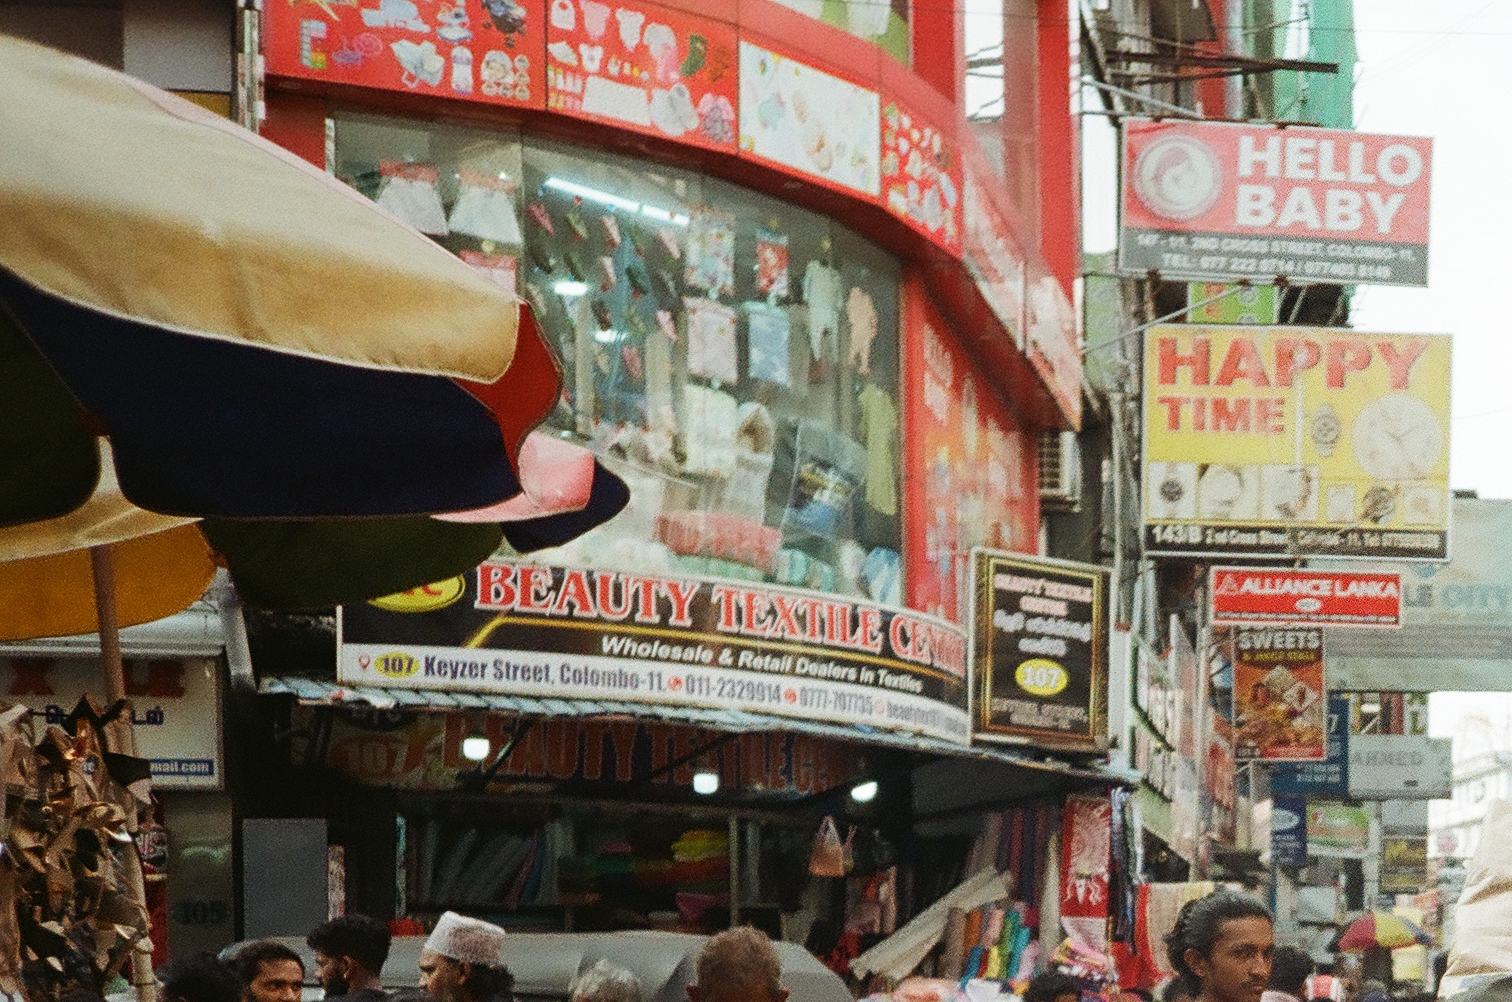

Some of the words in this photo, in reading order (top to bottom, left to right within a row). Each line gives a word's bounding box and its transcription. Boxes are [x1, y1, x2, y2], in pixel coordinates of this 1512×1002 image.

[1238, 135, 1423, 187] HELLO
[1236, 184, 1406, 235] BABY
[1158, 336, 1430, 391] HAPPY
[1158, 396, 1286, 434] TIME
[1239, 577, 1334, 596] ALLIANCE
[1335, 580, 1399, 598] LANKA
[474, 562, 699, 627] BEAUTY
[710, 586, 883, 655] TEXTILE
[601, 636, 714, 664] Wholesale
[718, 648, 733, 666] &
[738, 651, 793, 675] Retail
[795, 658, 858, 681] Dealers
[1238, 631, 1322, 651] SWEETS
[383, 655, 415, 674] 107
[424, 654, 488, 680] Keyzer
[1023, 665, 1060, 688] 107
[149, 761, 210, 773] mail.com
[346, 740, 409, 776] 107
